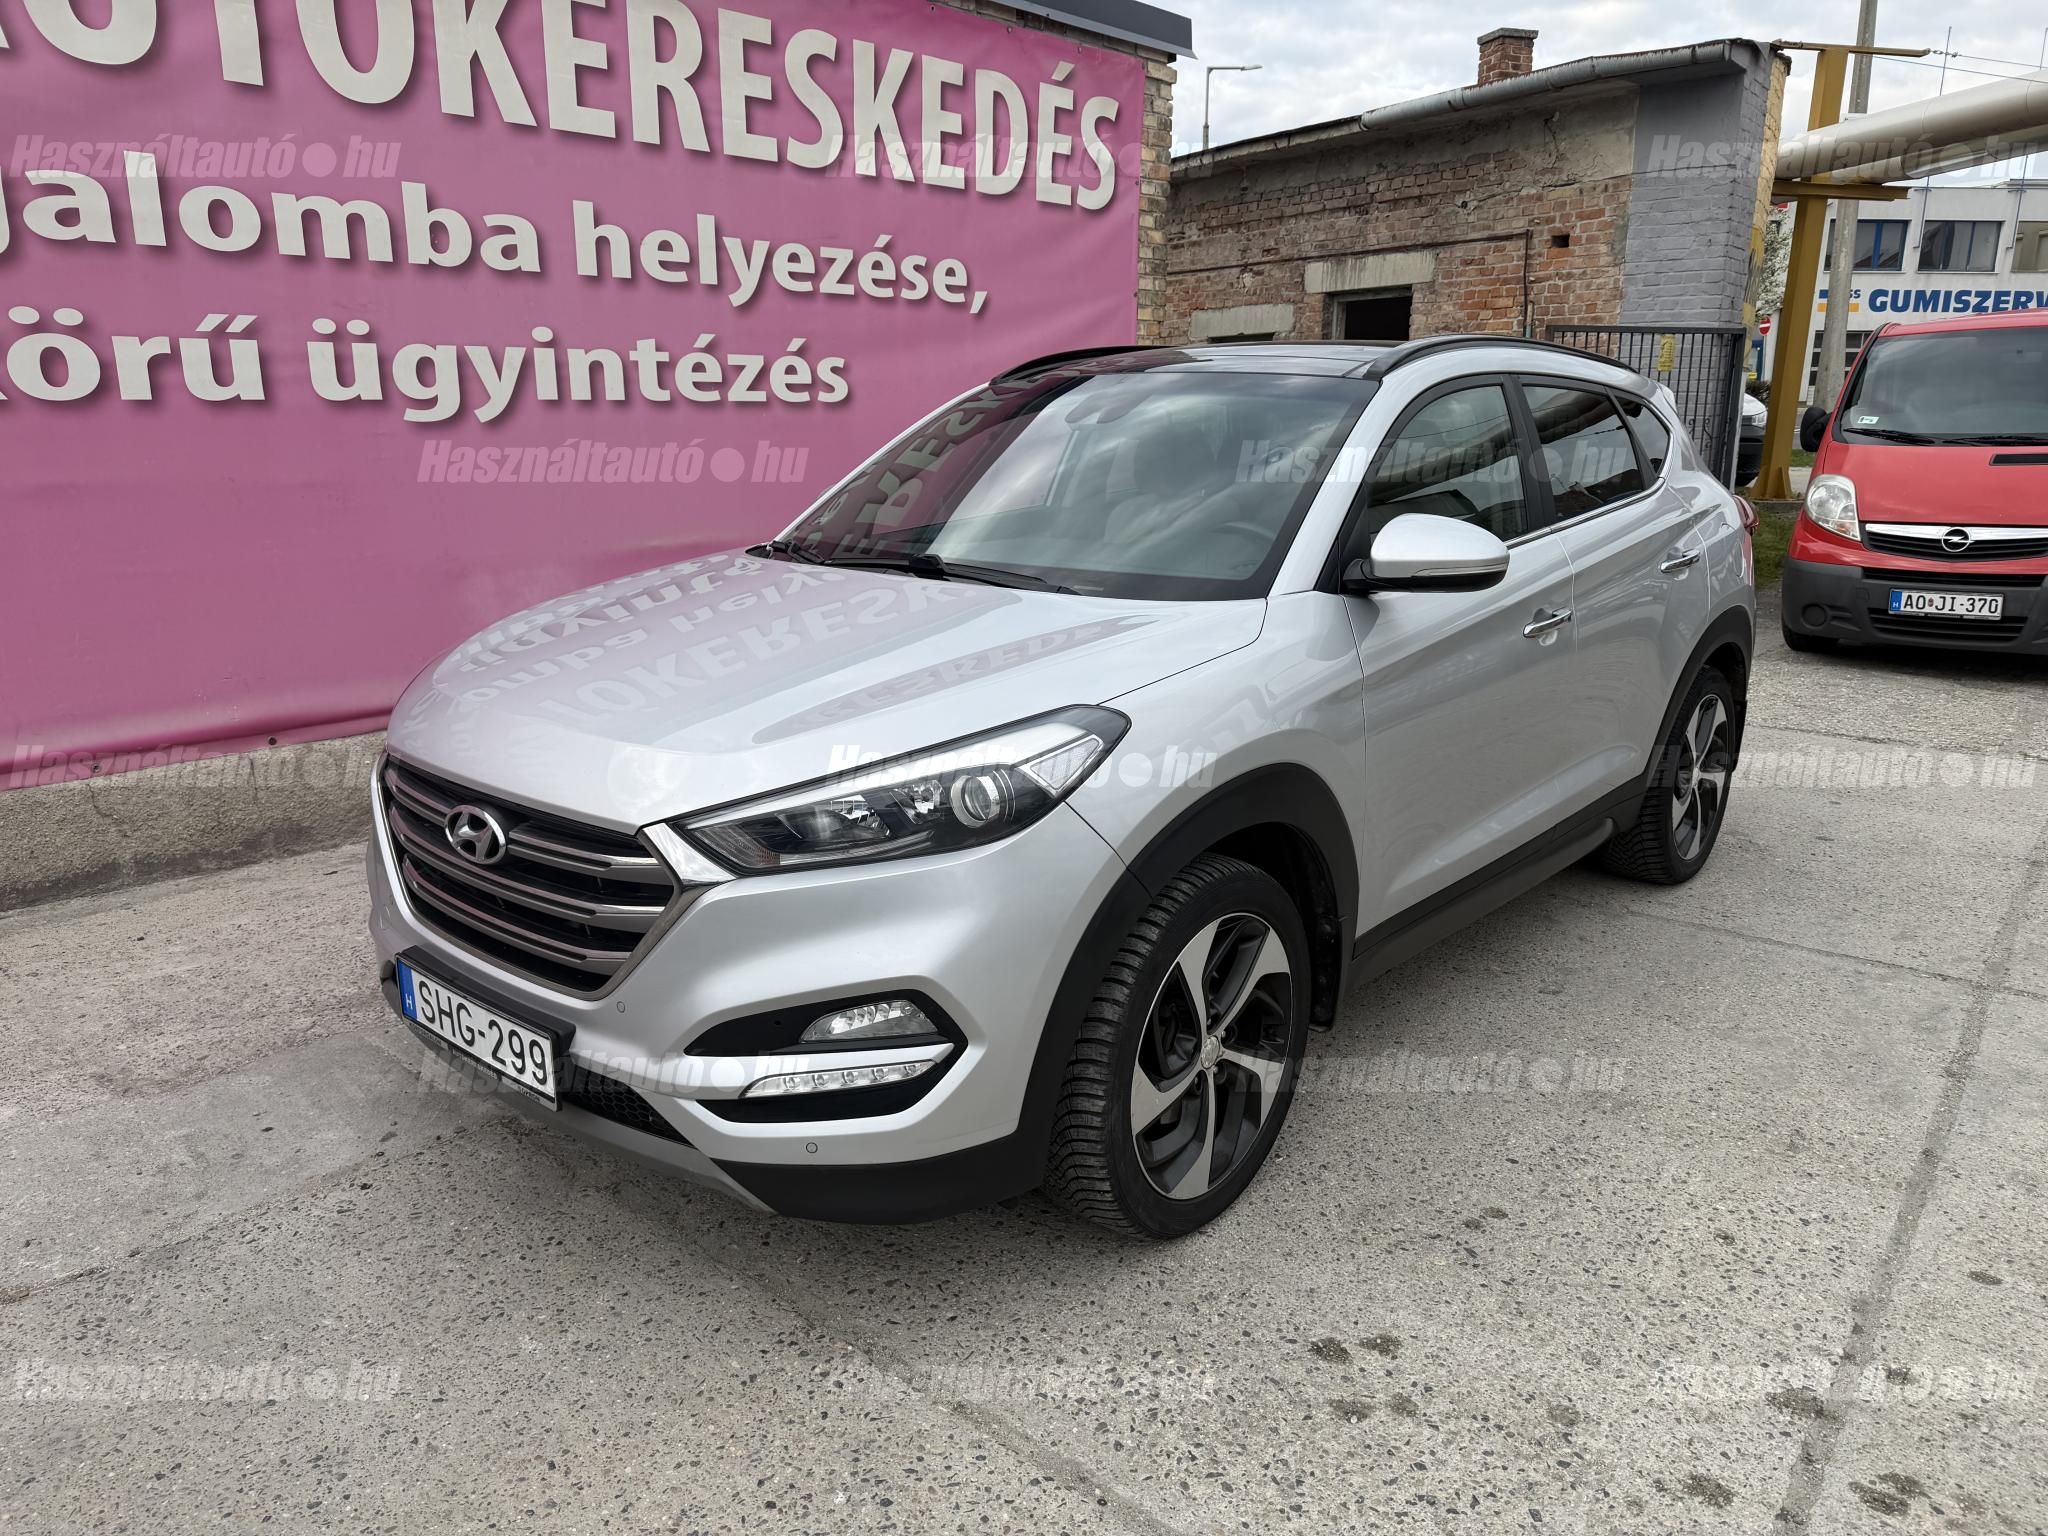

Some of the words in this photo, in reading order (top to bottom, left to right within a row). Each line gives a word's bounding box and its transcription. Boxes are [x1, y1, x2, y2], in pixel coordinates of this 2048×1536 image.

[0, 150, 541, 273] alomba
[572, 199, 988, 314] helyezése,
[0, 306, 266, 401] örű
[306, 318, 849, 423] ügyintézés
[1903, 594, 1926, 610] AO
[1935, 595, 1999, 614] JI-370
[405, 993, 413, 1011] H
[418, 980, 548, 1086] SHG-299
